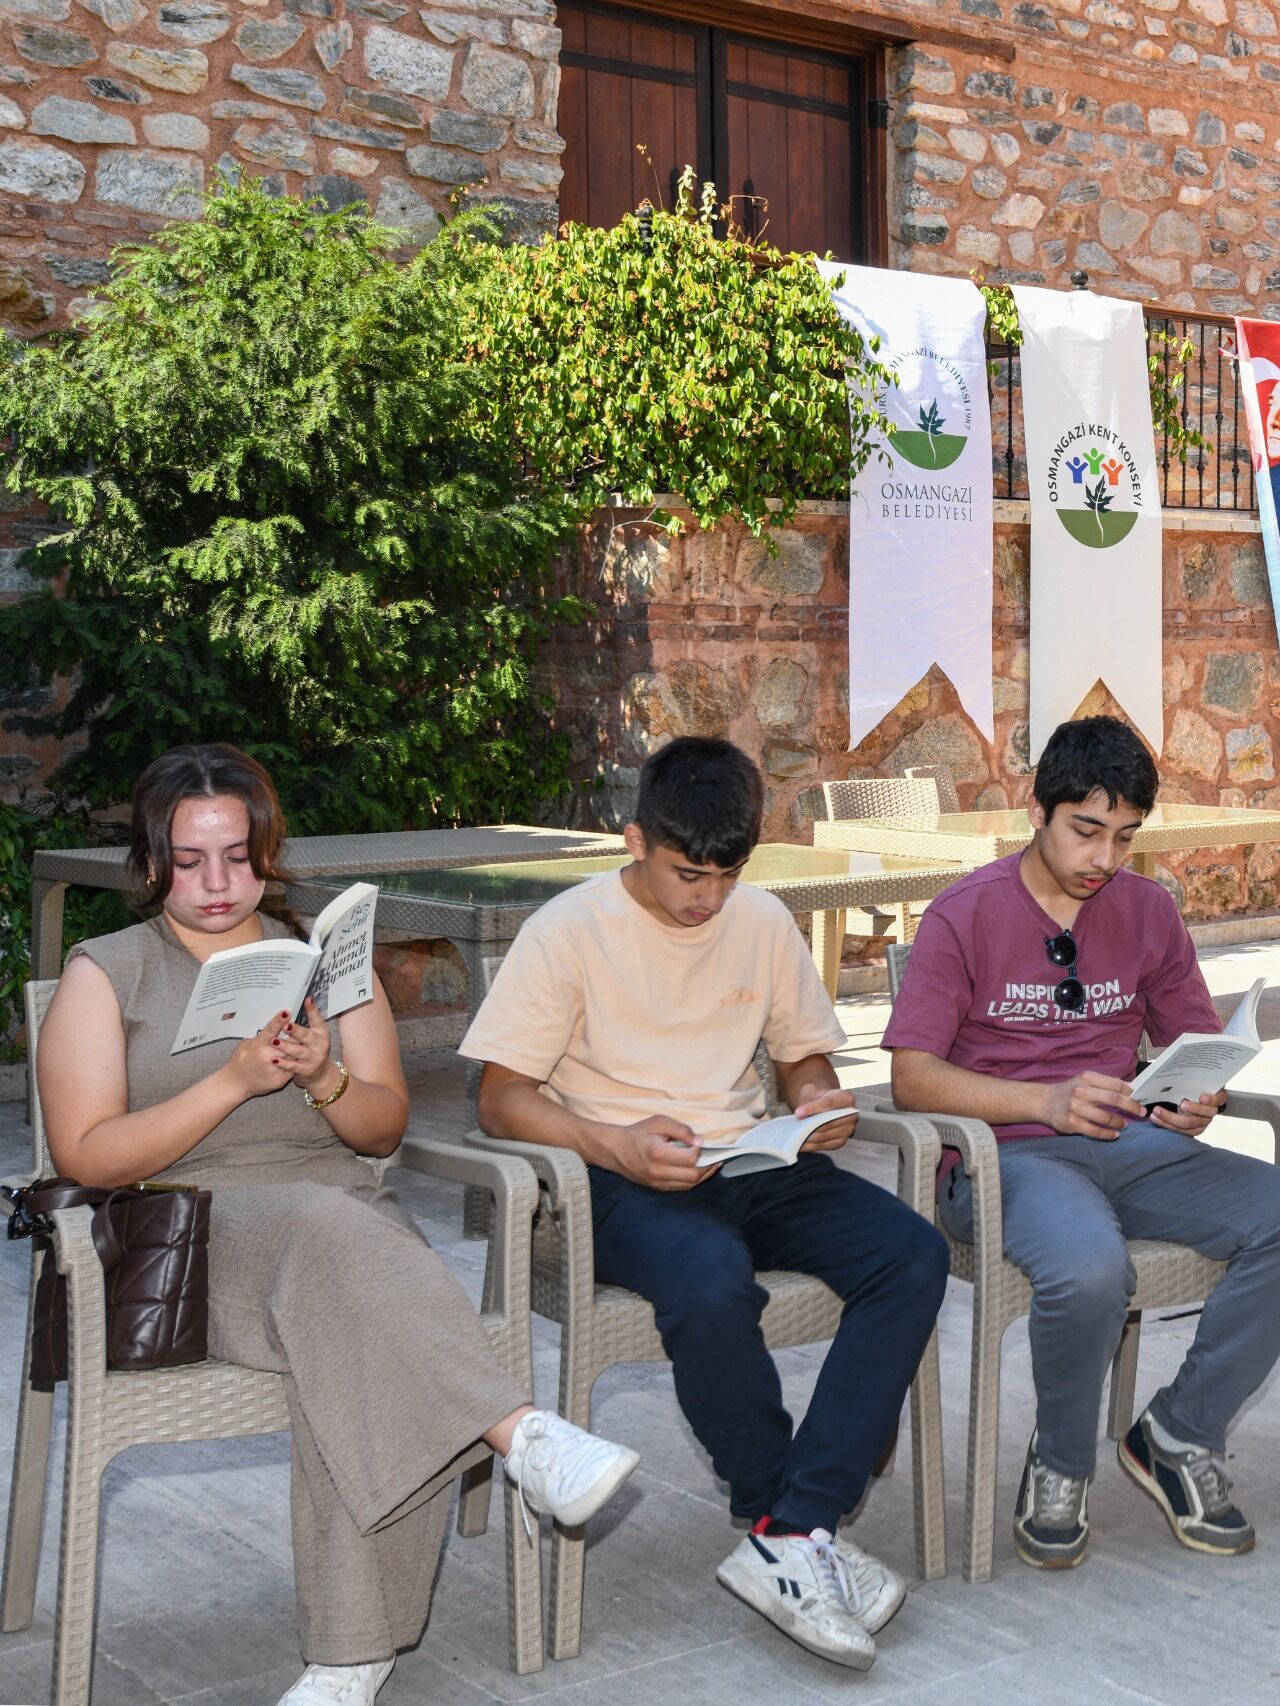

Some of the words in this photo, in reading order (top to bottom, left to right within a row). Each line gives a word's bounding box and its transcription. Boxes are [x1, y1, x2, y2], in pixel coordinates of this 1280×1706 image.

[879, 386, 888, 417] URSA
[1048, 422, 1086, 502] OSMANGAZİ
[1089, 423, 1119, 444] KENT
[1118, 441, 1144, 507] KONSEYİ
[881, 482, 972, 504] OSMANGAZİ
[882, 504, 972, 522] BELEDİYESİ
[1006, 979, 1120, 1000] INSPIION
[987, 1001, 1049, 1019] LEADS
[1093, 993, 1136, 1016] WAY
